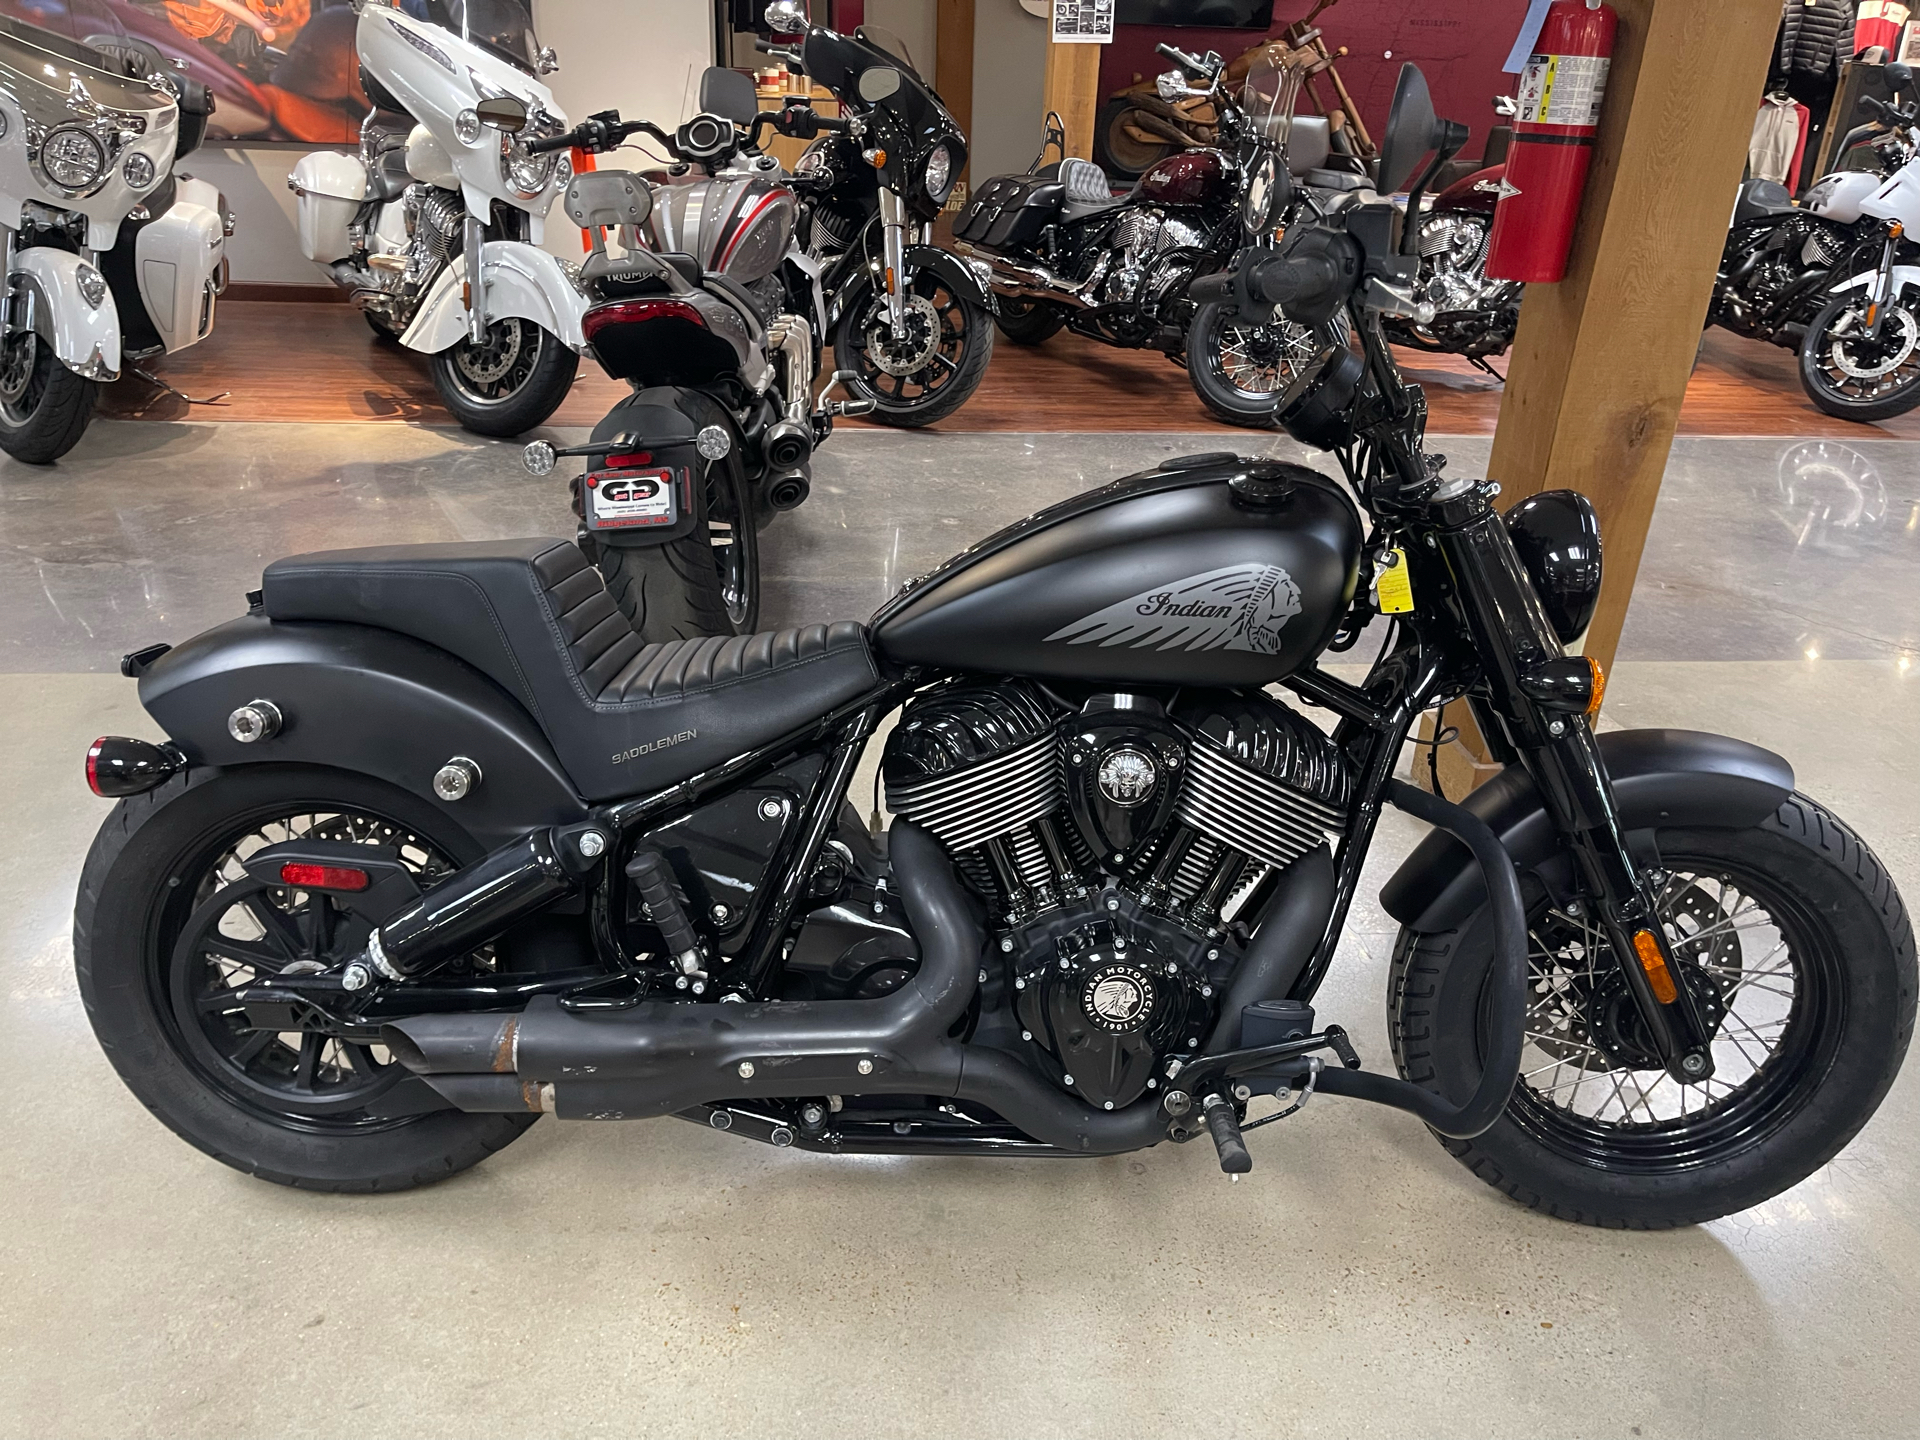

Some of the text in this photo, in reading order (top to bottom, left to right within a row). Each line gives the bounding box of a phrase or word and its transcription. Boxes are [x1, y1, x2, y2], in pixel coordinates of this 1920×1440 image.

[1549, 62, 1555, 72] A
[1545, 84, 1551, 94] B
[1541, 106, 1547, 116] C
[1136, 592, 1233, 619] Indian
[611, 728, 698, 765] SADDLEMEN
[1084, 966, 1154, 1021] INDIAN MOTORCYCLE
[1102, 1021, 1129, 1031] 1901
